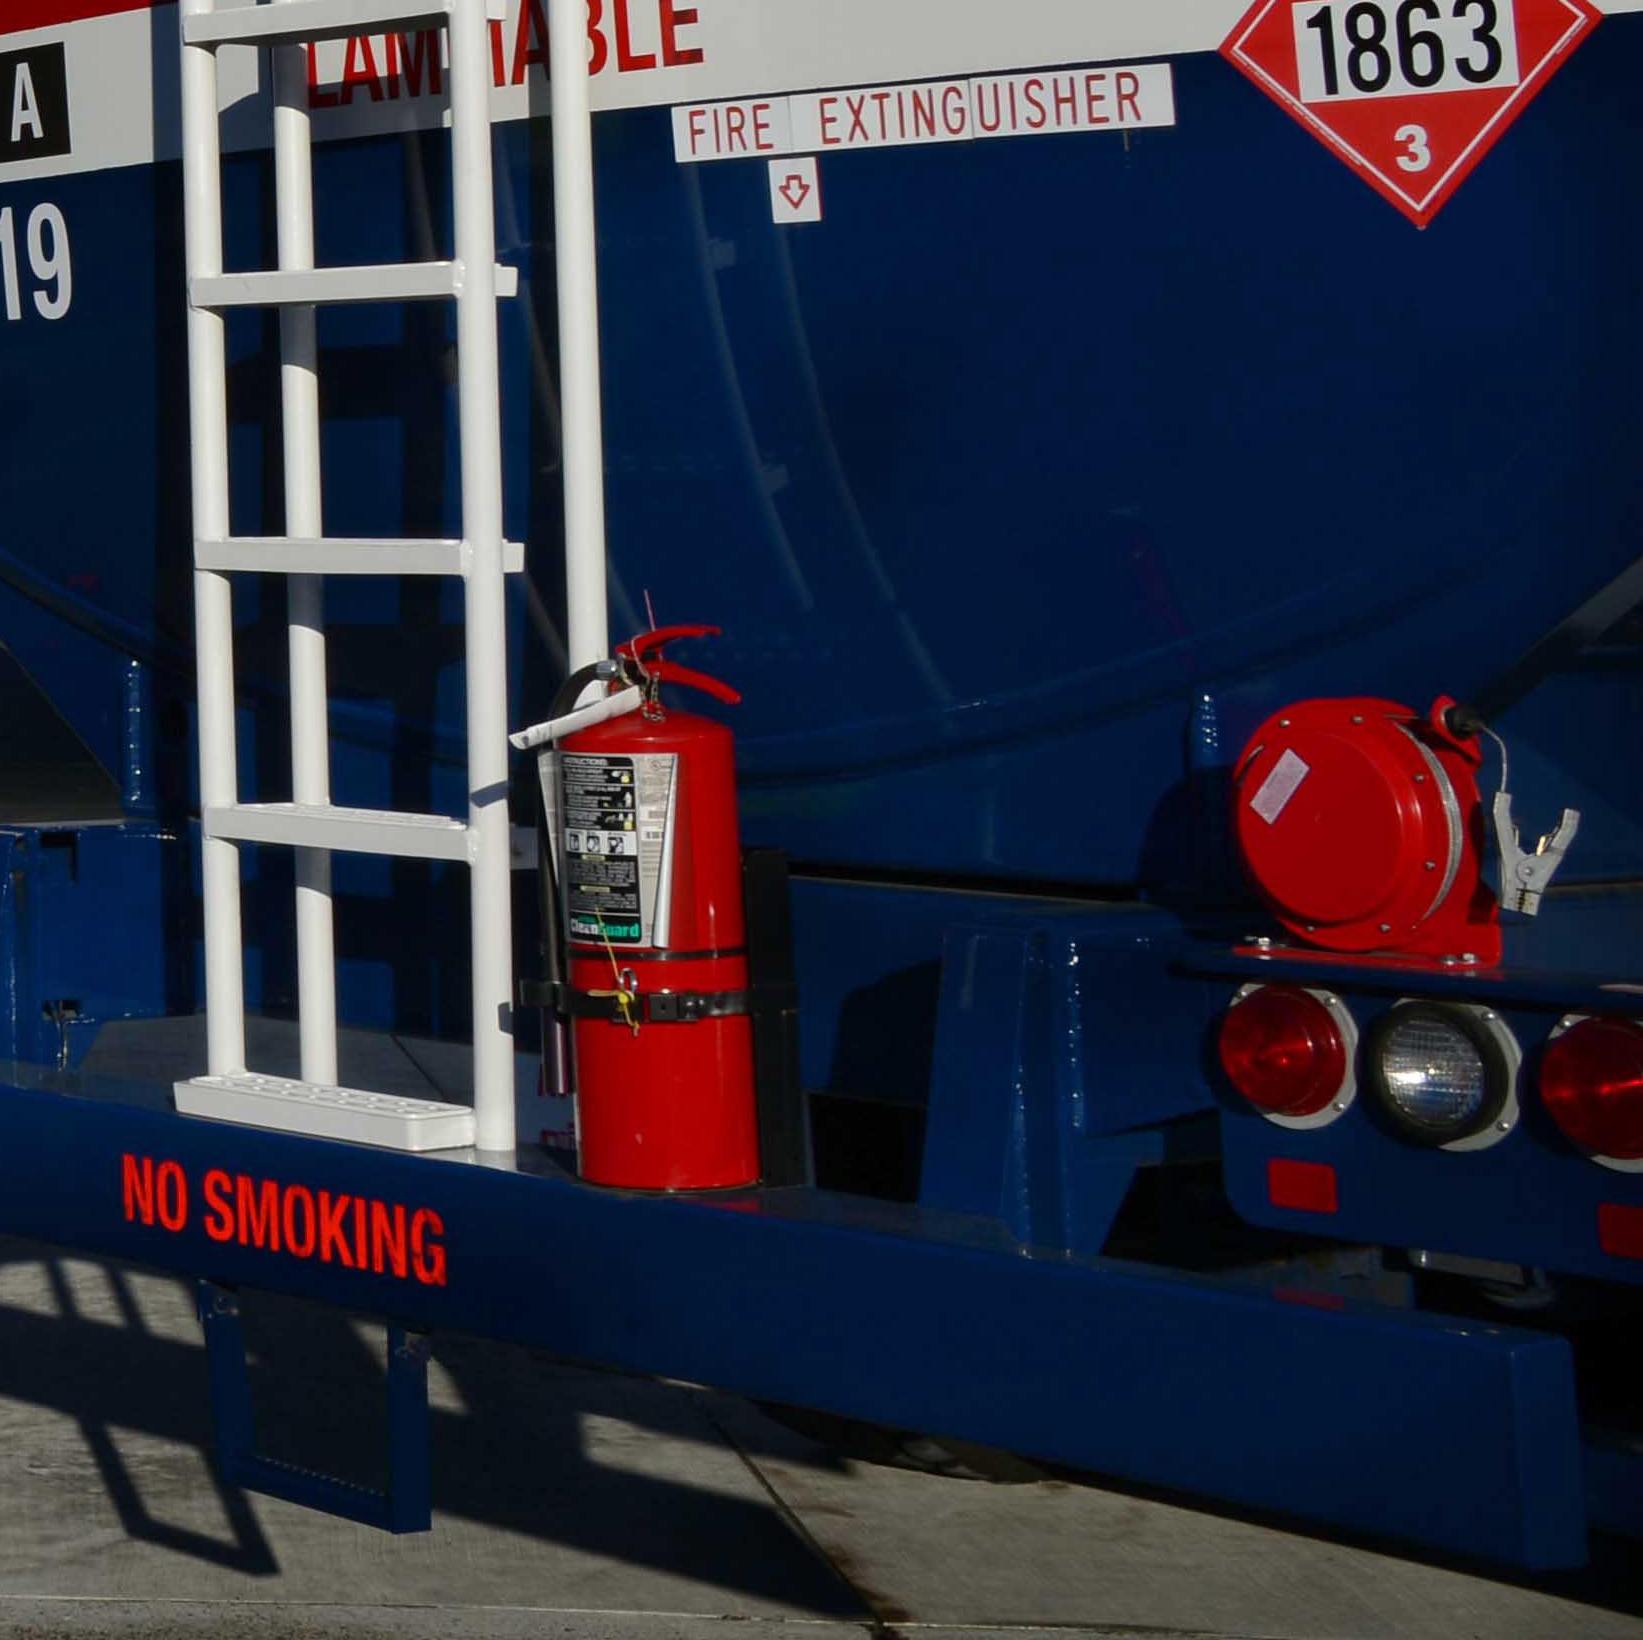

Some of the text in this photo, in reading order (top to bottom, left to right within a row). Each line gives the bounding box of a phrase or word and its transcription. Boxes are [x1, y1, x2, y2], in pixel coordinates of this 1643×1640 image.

[10, 61, 45, 143] A
[687, 71, 1143, 152] FIRE EXTINGUISHER
[1393, 123, 1432, 173] 3
[122, 1153, 448, 1287] NO SMOKING
